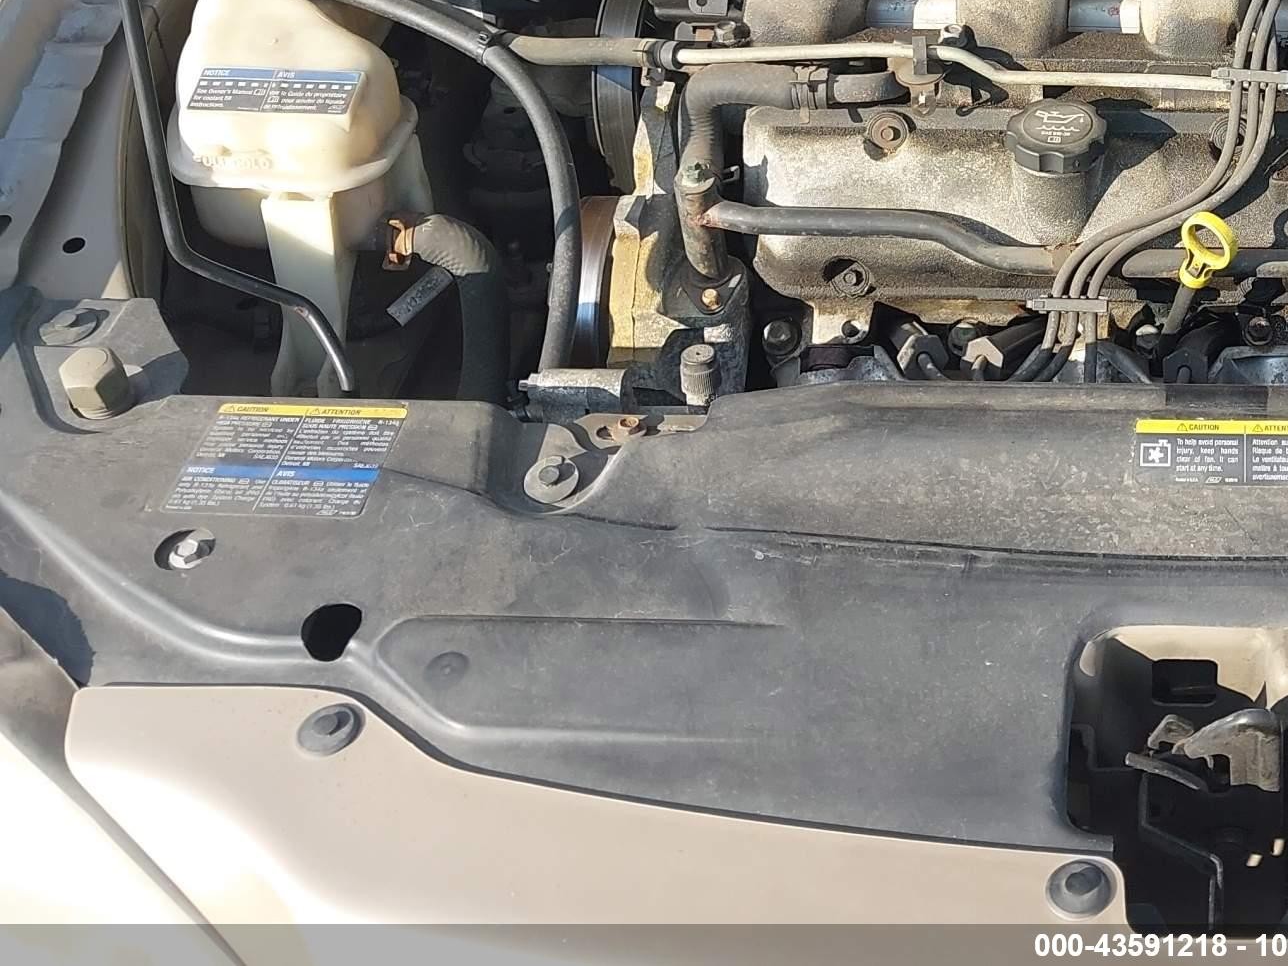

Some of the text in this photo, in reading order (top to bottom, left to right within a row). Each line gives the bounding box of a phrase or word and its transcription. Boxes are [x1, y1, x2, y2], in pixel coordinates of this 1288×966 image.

[276, 71, 296, 79] AVIS
[1185, 438, 1196, 446] help
[1176, 447, 1195, 455] injury,
[1200, 447, 1214, 455] keep
[1252, 446, 1272, 455] Risque
